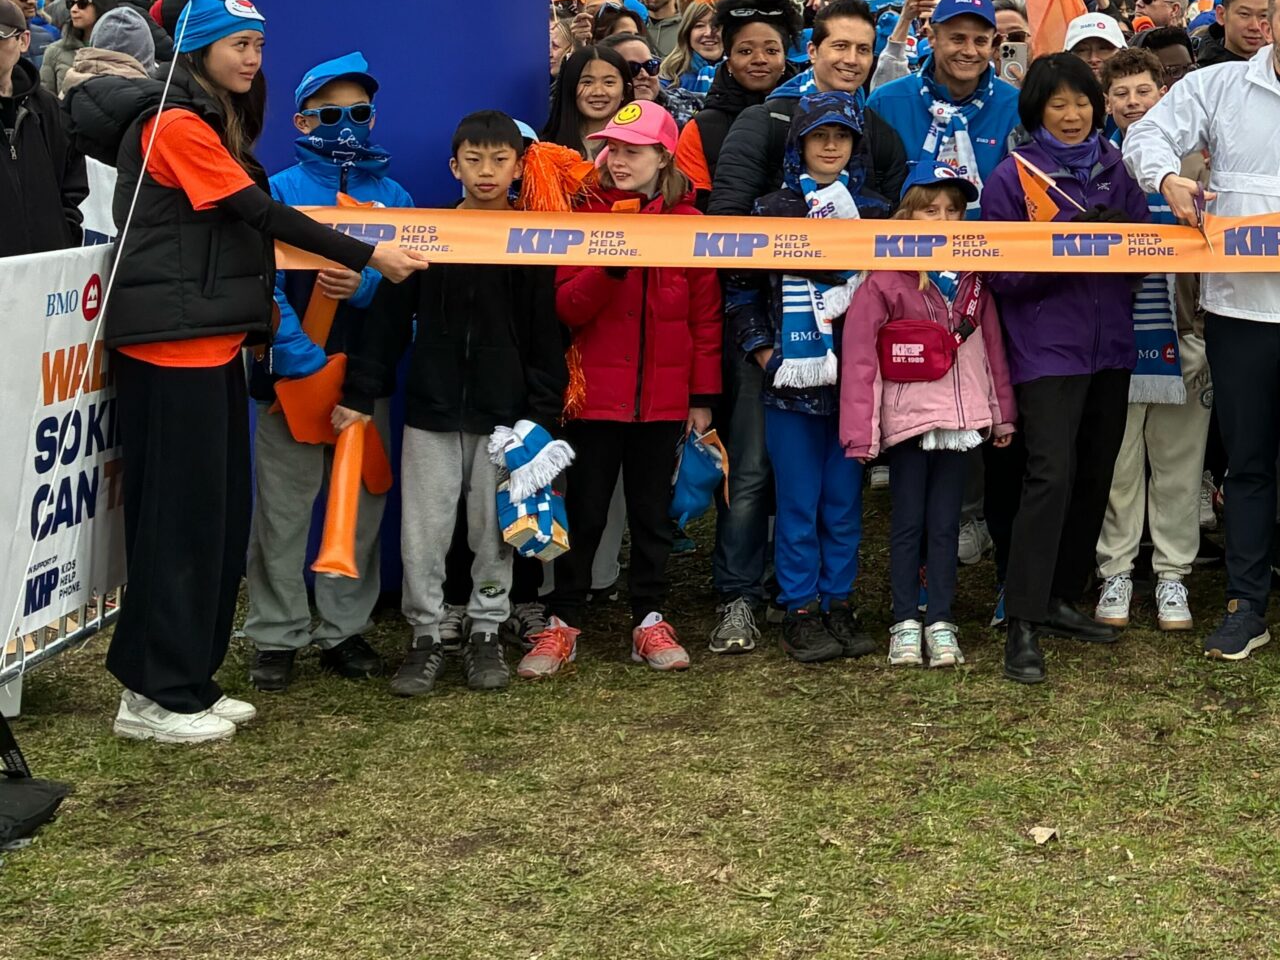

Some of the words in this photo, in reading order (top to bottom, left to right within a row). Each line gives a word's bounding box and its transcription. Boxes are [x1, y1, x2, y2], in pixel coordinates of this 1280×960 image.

[320, 223, 397, 247] HP
[401, 235, 438, 243] HELP
[402, 226, 436, 235] KIDS
[507, 228, 584, 254] KHP
[591, 231, 624, 239] KIDS
[589, 239, 626, 248] HELP
[693, 233, 769, 257] KHP
[875, 235, 947, 257] KHP
[1052, 234, 1122, 256] KHP
[1128, 239, 1163, 248] HELP
[46, 289, 79, 317] BMO
[791, 330, 821, 341] BMO
[1138, 349, 1159, 359] MO
[42, 339, 108, 406] WAL
[34, 408, 82, 474] SO
[85, 398, 122, 457] KI
[30, 465, 99, 542] CAN
[61, 559, 76, 574] KIDS
[60, 571, 76, 587] HELP
[23, 566, 60, 617] KHP
